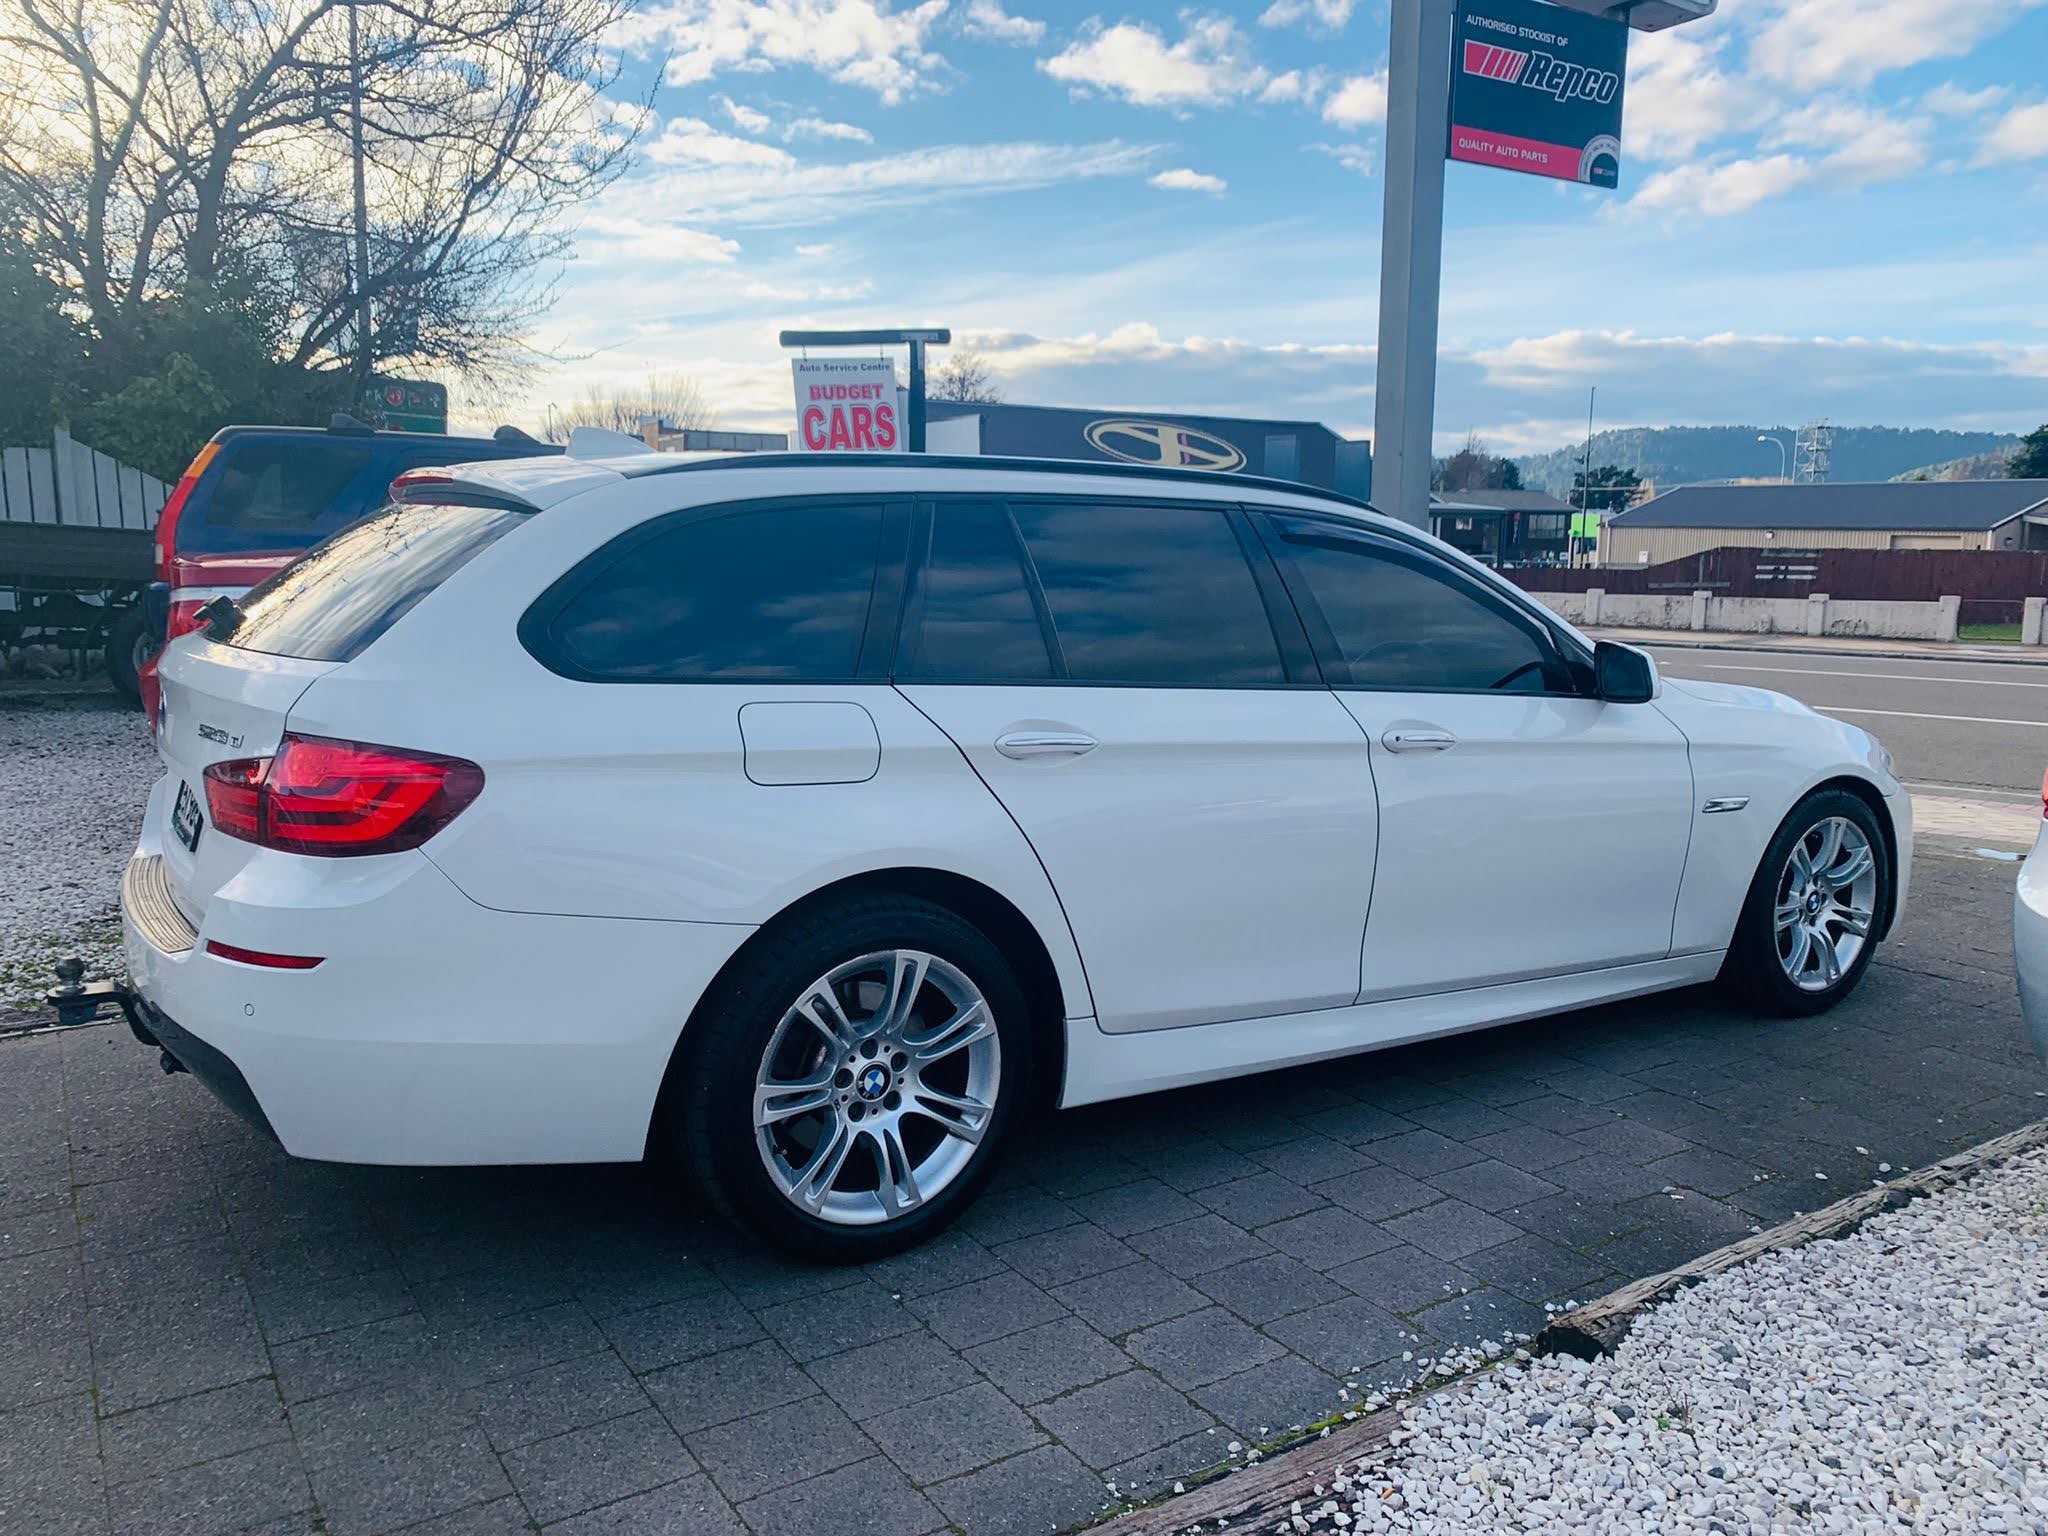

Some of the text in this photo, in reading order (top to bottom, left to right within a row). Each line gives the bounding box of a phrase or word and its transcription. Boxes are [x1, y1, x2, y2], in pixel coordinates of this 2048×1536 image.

[1466, 14, 1569, 46] AUTHORISED STOCKIST OF
[1522, 49, 1619, 104] Repco
[1458, 137, 1548, 164] QUALITY AUTO PARTS
[799, 363, 890, 372] Auto Service Centre
[809, 383, 884, 400] BUDGET
[803, 402, 897, 451] CARS
